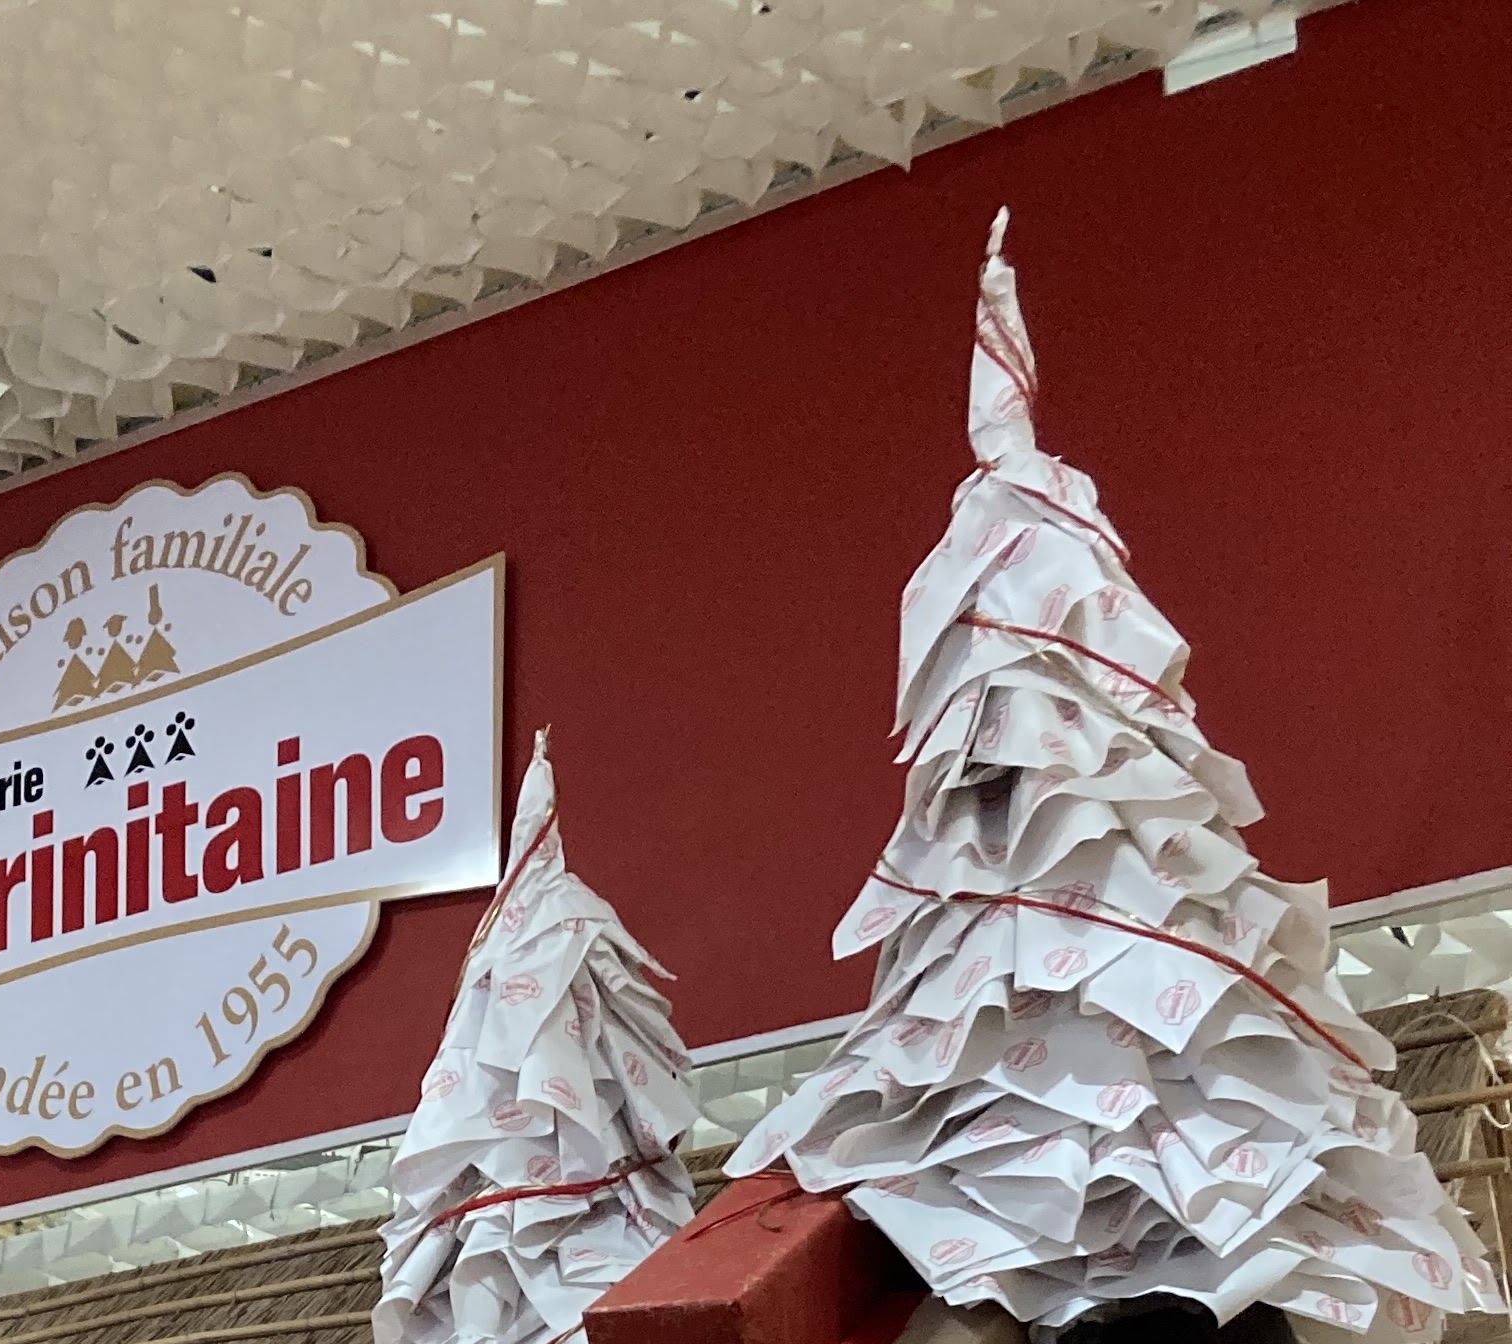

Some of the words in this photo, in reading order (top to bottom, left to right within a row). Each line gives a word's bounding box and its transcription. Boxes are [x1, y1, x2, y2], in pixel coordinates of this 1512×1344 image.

[110, 513, 312, 616] familiale
[116, 1056, 182, 1111] en
[195, 923, 318, 1068] 1955
